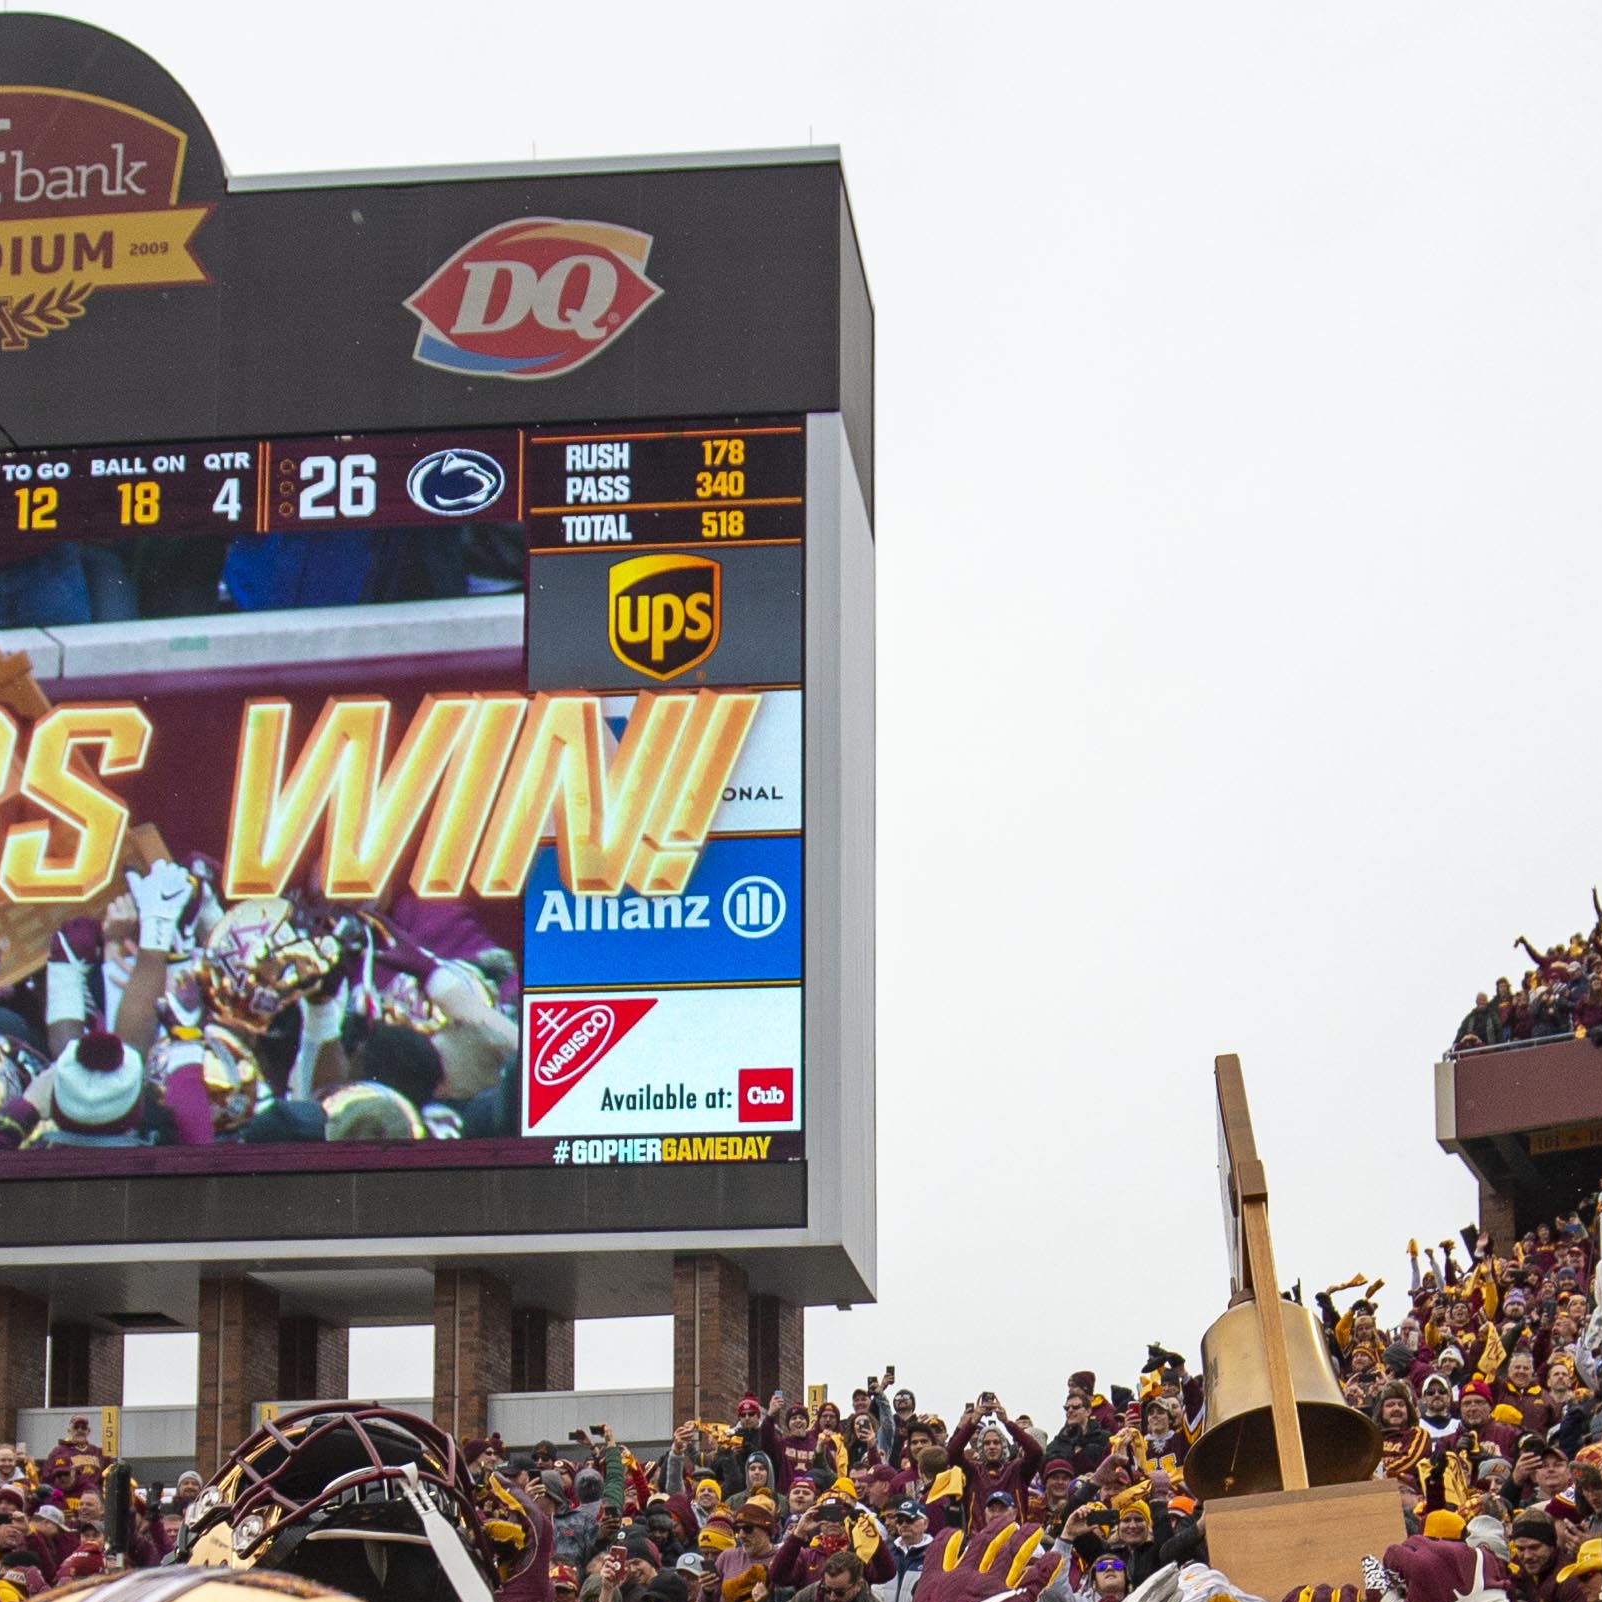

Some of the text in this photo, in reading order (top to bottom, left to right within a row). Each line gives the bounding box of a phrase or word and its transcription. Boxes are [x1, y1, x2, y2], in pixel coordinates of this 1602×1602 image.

[128, 240, 169, 258] 2009
[450, 252, 619, 340] DQ
[3, 461, 71, 483] TO GO
[91, 454, 187, 477] BALL ON
[204, 451, 250, 471] QTR
[565, 438, 746, 473] RUSH 178
[117, 480, 161, 526] 18
[211, 477, 243, 522] 4
[298, 452, 378, 521] 26
[564, 469, 746, 505] PASS 340
[14, 486, 59, 531] 12
[562, 510, 745, 544] TOTAL 518
[617, 589, 712, 662] ups
[535, 889, 711, 933] Allianz
[539, 1011, 609, 1080] NABISCO
[600, 1083, 733, 1112] Available at:
[746, 1085, 786, 1105] Cub
[552, 1135, 773, 1165] #GOPHERGAMEDAY
